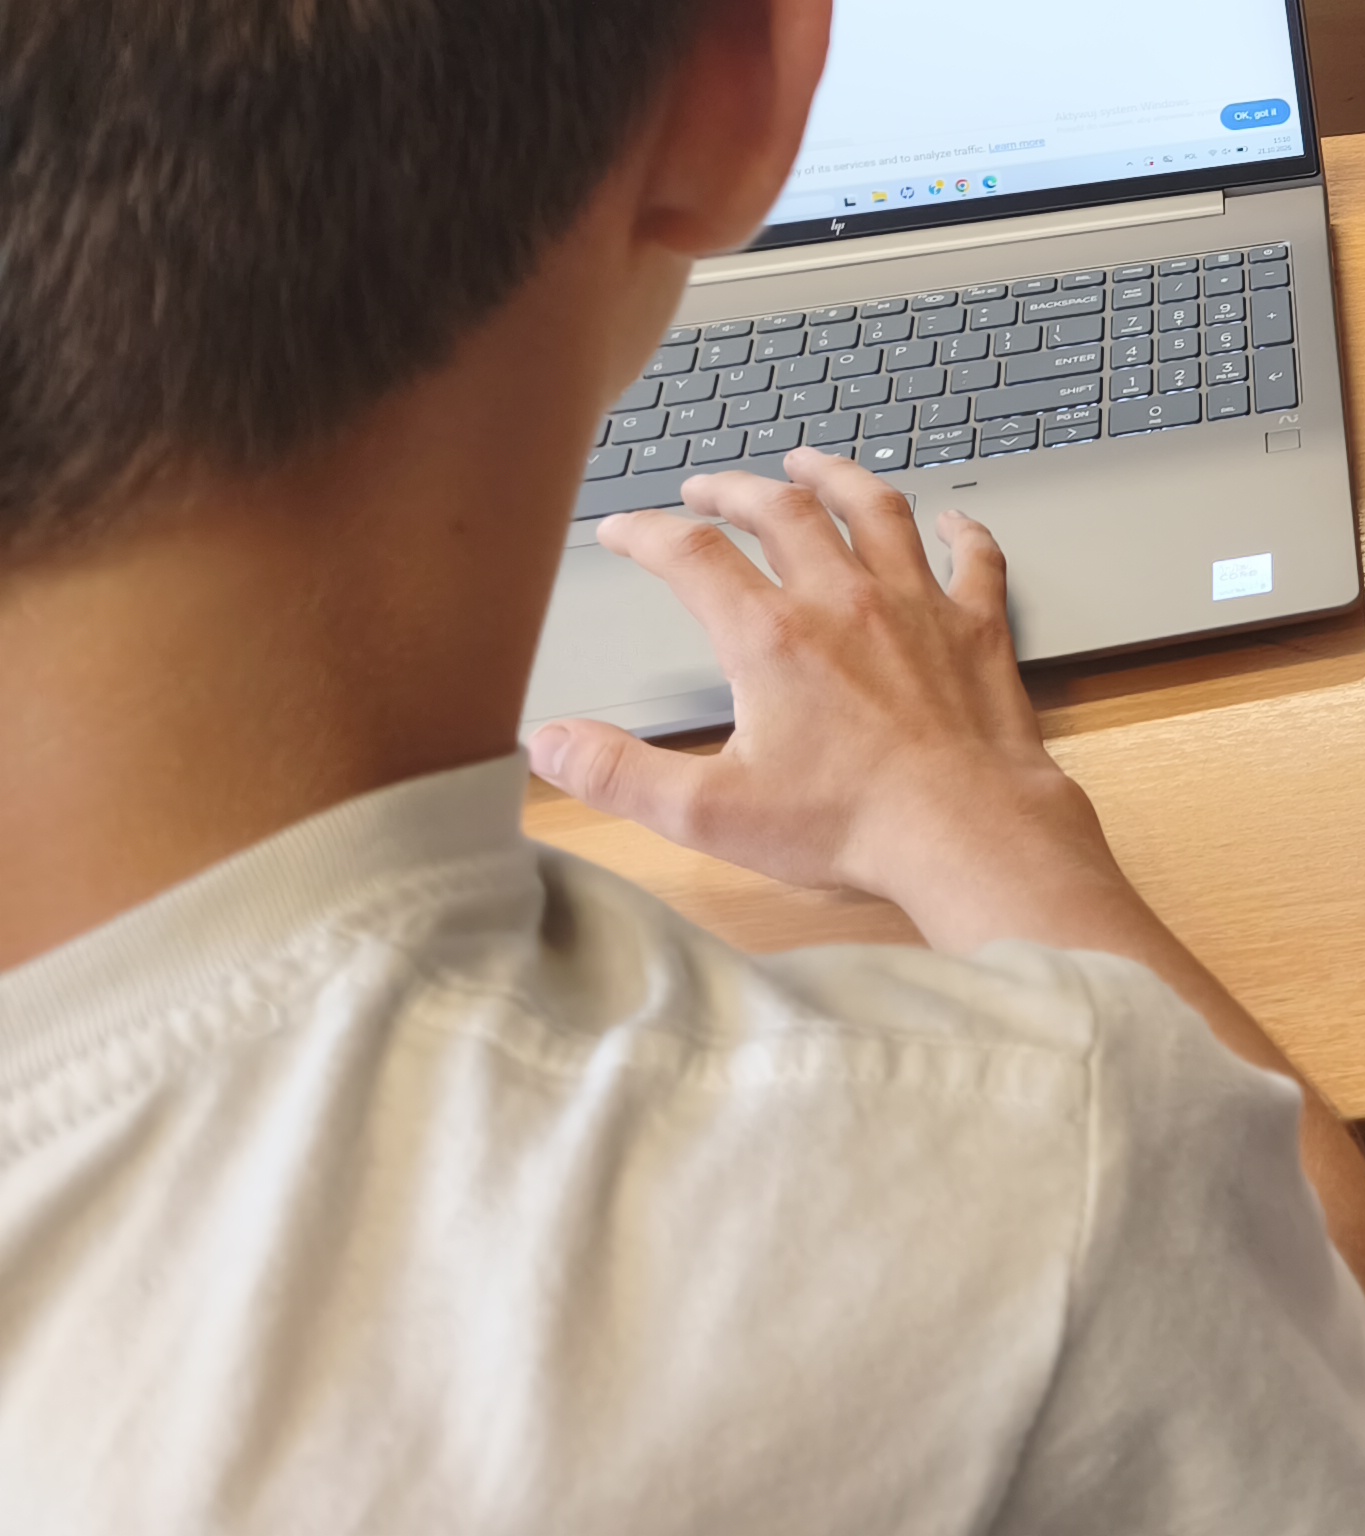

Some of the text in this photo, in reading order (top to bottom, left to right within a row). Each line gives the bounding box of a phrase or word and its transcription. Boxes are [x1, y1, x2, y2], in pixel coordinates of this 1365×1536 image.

[1234, 108, 1276, 121] OK, got it
[805, 138, 1045, 174] of its services and to analyze traffic. Learn more
[1030, 295, 1098, 311] BACKSPACE
[1220, 304, 1230, 313] 9
[1174, 311, 1184, 320] 8
[1128, 317, 1137, 326] 7
[1221, 333, 1231, 341] 6
[1174, 339, 1184, 348] 5
[1126, 346, 1137, 355] 4
[1055, 354, 1095, 365] ENTER
[1223, 363, 1232, 372] 3
[1174, 370, 1185, 379] 2
[1128, 377, 1135, 386] 1
[1060, 385, 1095, 395] SHIFT
[1150, 406, 1162, 415] 0
[930, 432, 945, 440] PG
